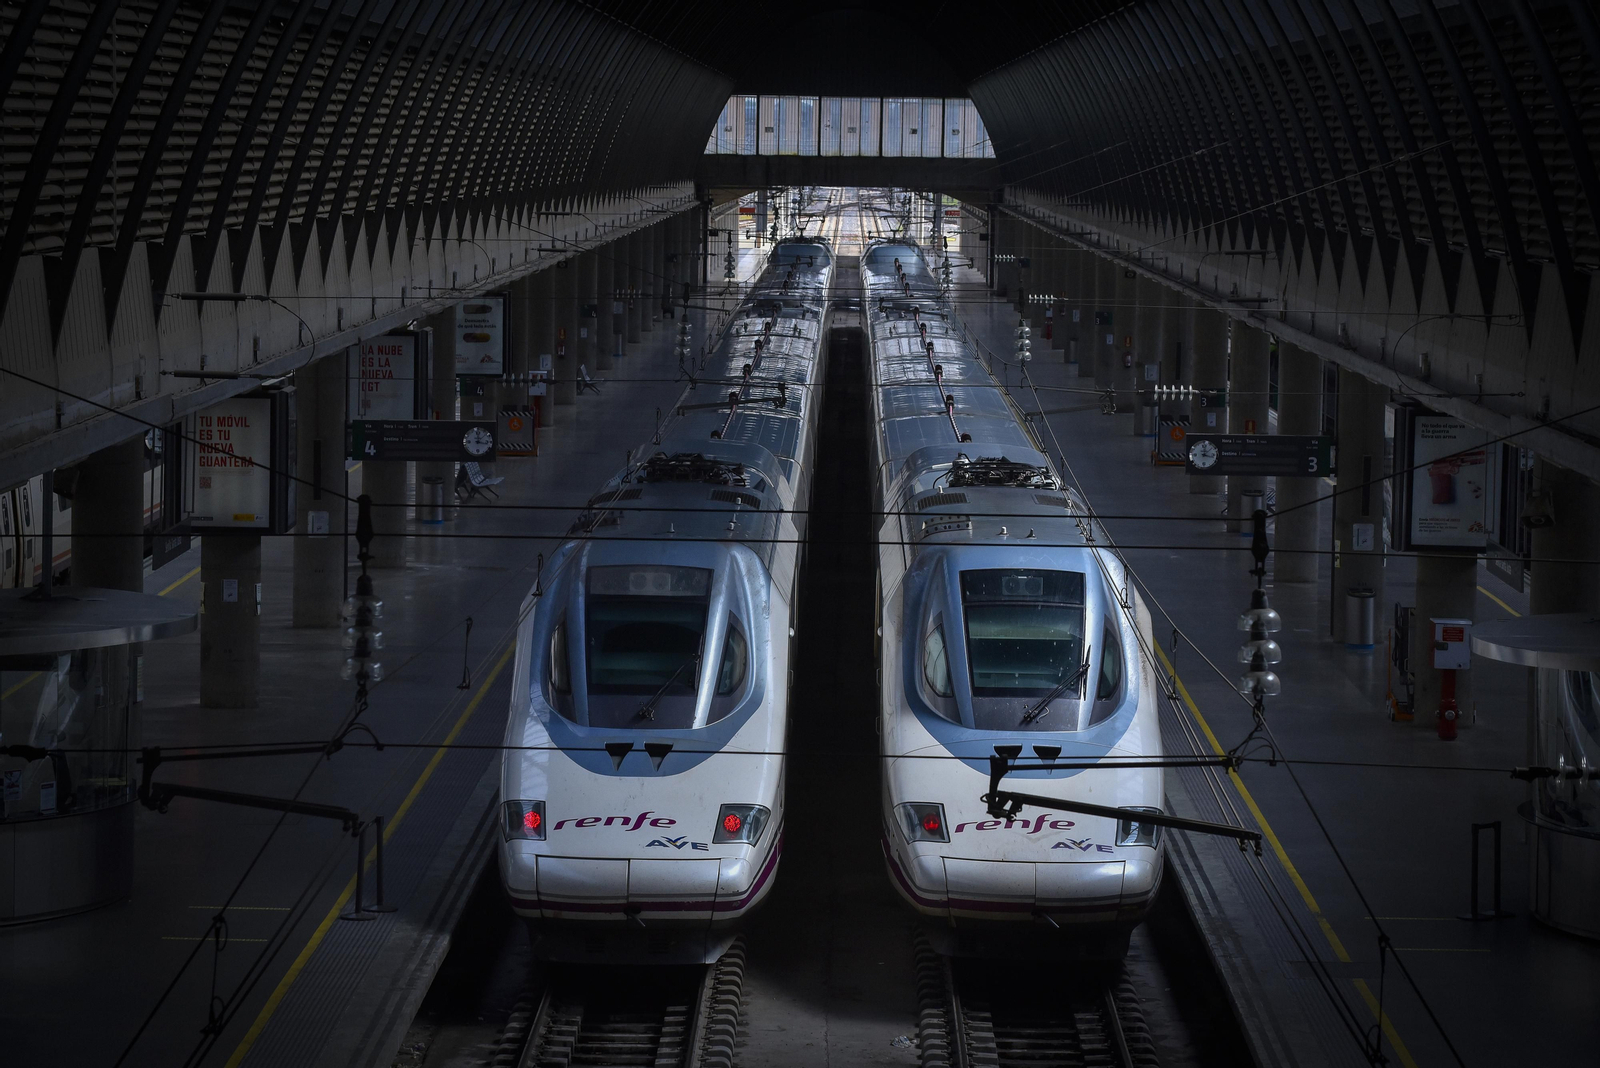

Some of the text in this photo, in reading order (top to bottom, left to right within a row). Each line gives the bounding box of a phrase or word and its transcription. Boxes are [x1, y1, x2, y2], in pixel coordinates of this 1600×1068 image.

[362, 345, 403, 356] LA NUBE
[362, 357, 391, 368] ES LA
[361, 369, 394, 380] NUEVA
[476, 387, 484, 396] 4
[1201, 397, 1207, 407] 3
[199, 414, 250, 428] TU MÓVIL
[199, 430, 230, 441] ES TU
[199, 443, 235, 454] NUEVA
[365, 440, 377, 456] 4
[199, 456, 254, 468] GUANTERA
[1308, 457, 1318, 472] 3
[553, 811, 677, 832] renfe
[954, 813, 1075, 835] renfe
[645, 835, 710, 852] AVE
[1050, 837, 1114, 854] AVE
